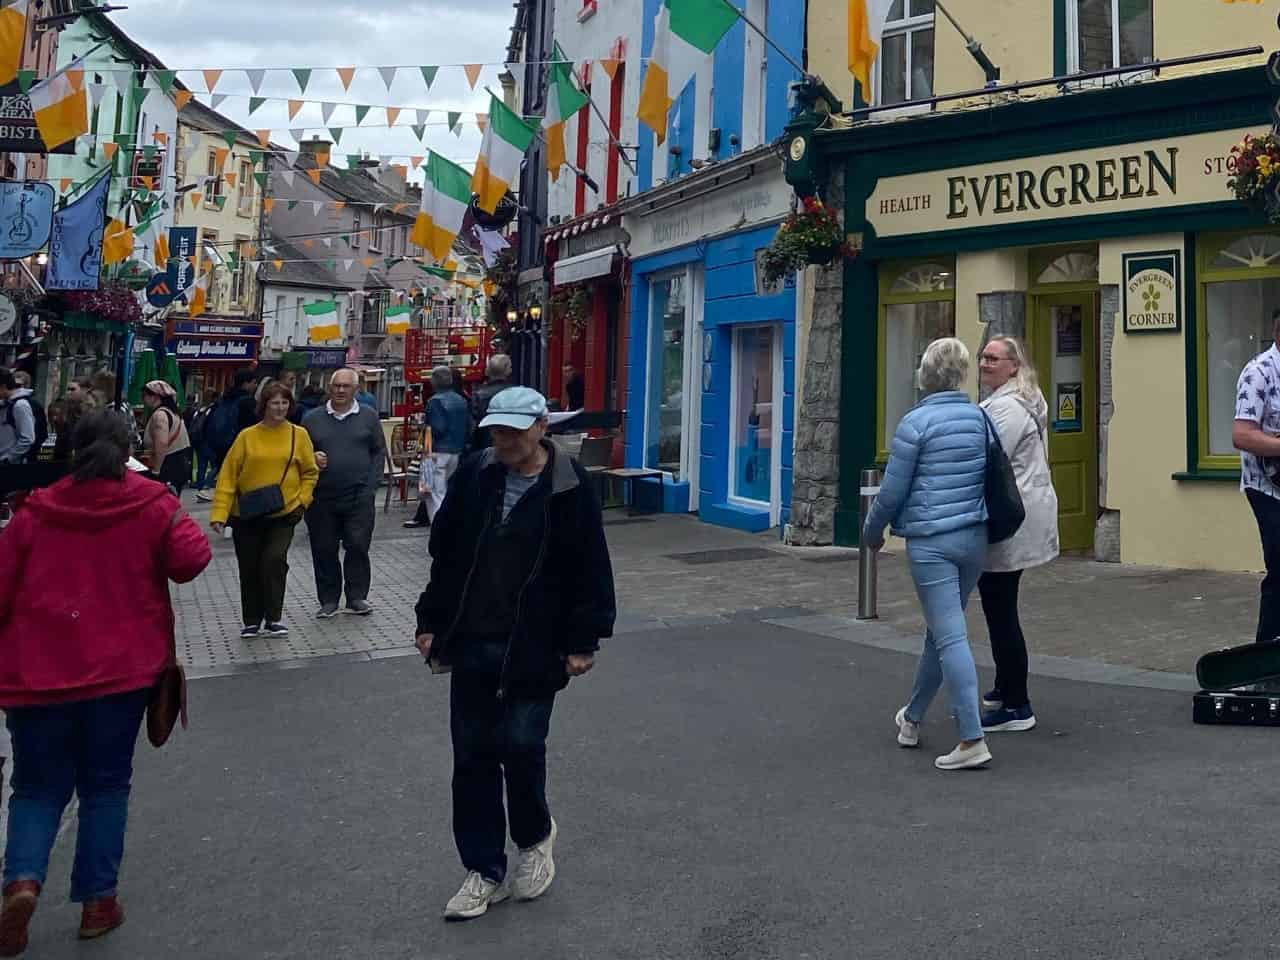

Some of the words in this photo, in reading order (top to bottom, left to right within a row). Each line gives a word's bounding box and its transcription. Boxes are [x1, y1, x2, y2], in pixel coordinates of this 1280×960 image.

[0, 95, 32, 112] KIN
[0, 109, 34, 119] HEA
[0, 125, 38, 139] BIST
[879, 194, 932, 215] HEALTH
[946, 147, 1179, 220] EVERGREEN
[1204, 154, 1237, 176] STO
[47, 279, 90, 289] MUSIC
[1129, 273, 1174, 294] EVERGREEN
[1129, 312, 1176, 326] CORNER
